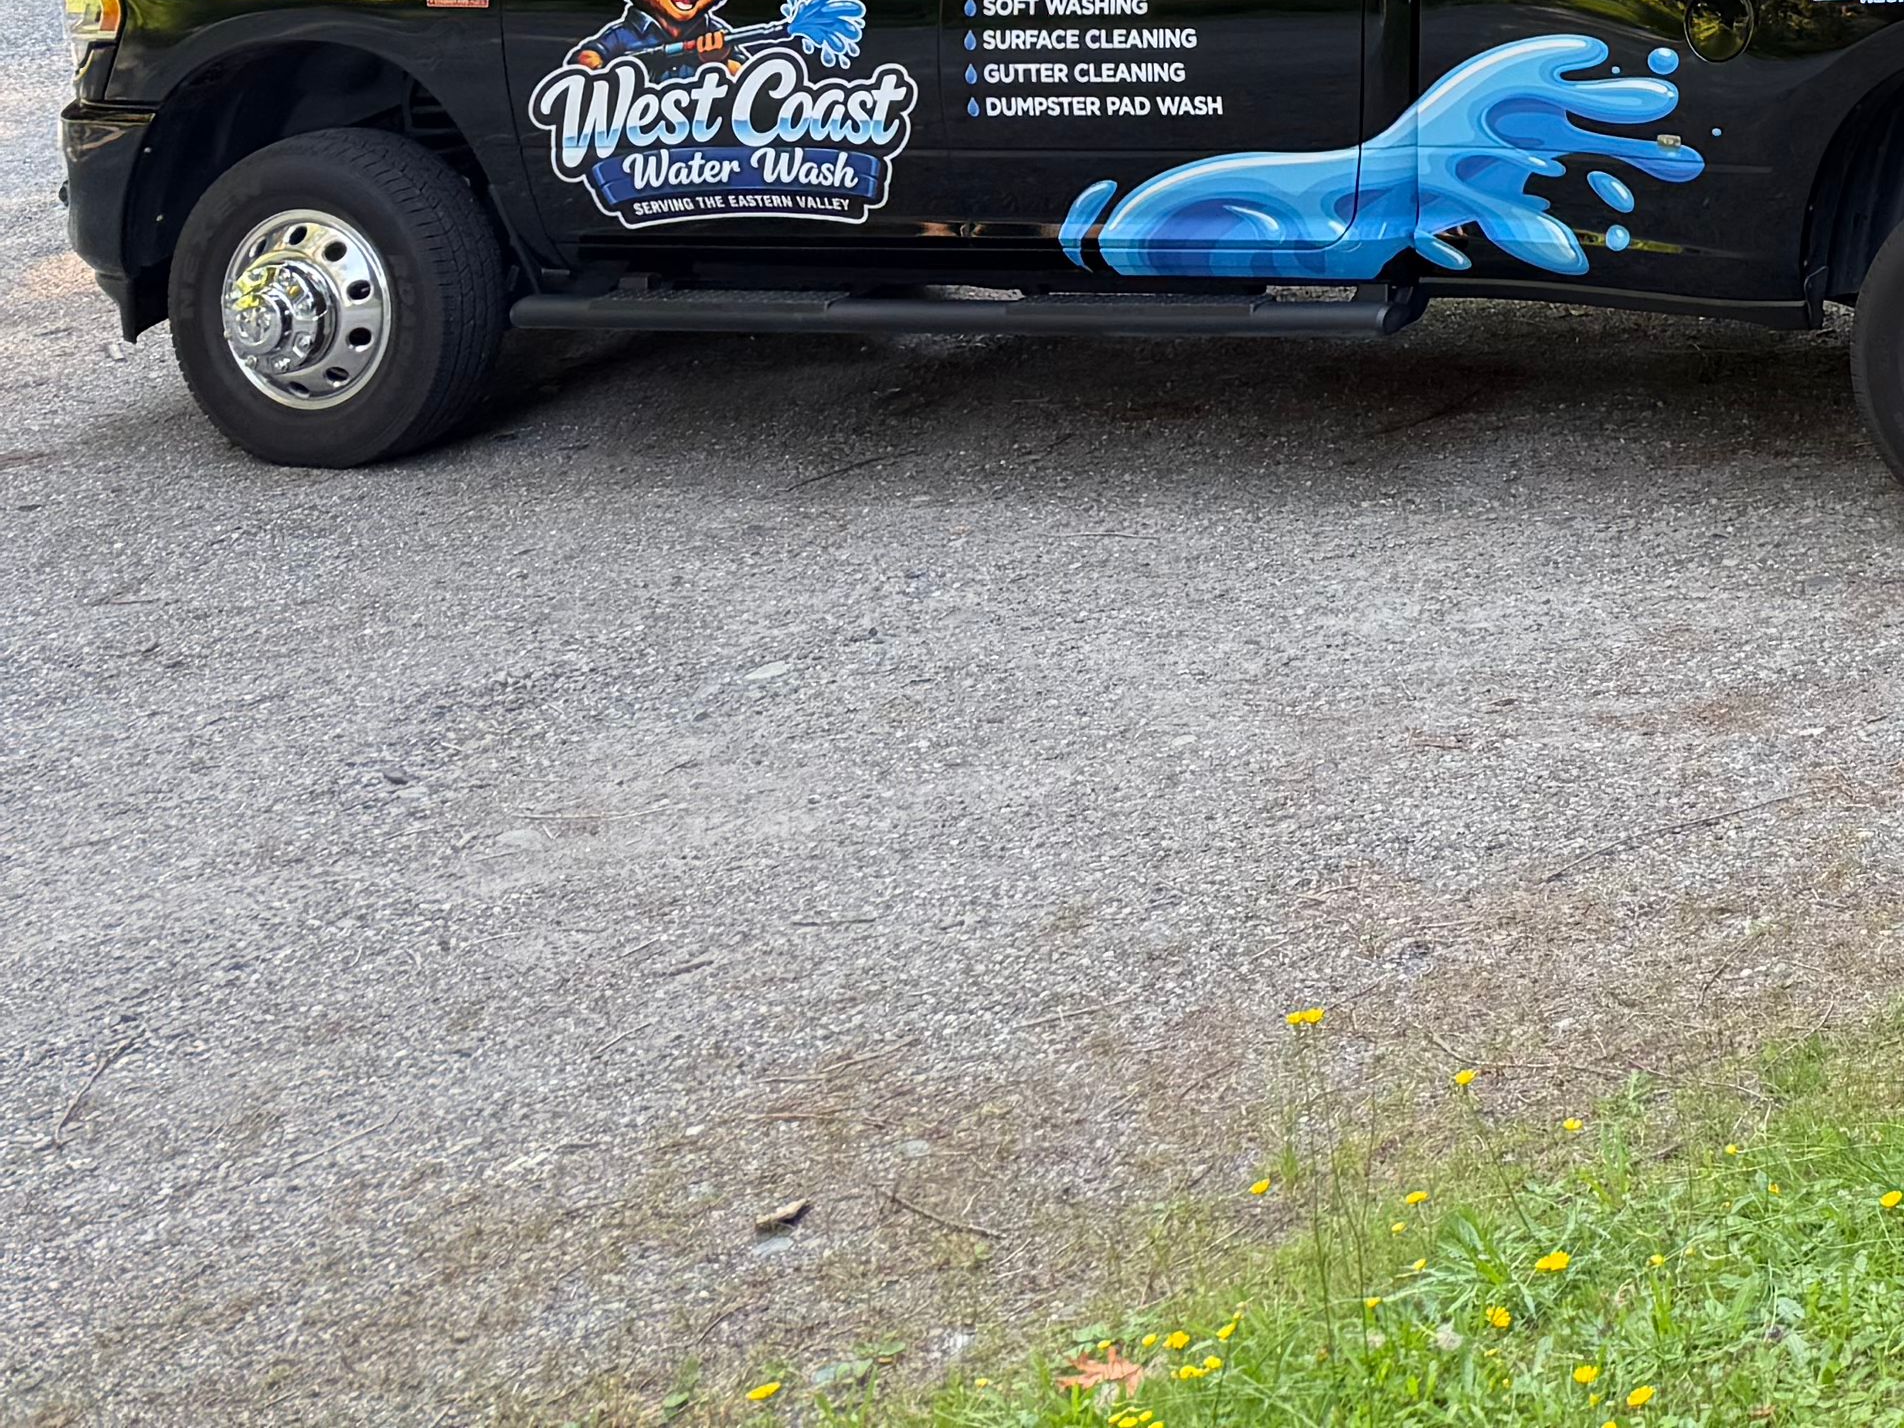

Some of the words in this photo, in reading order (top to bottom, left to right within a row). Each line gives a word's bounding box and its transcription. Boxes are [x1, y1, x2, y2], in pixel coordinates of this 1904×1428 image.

[983, 29, 1080, 50] SURFACE
[1085, 29, 1197, 49] CLEANING
[983, 63, 1068, 83] GUTTER
[1074, 63, 1185, 83] CLEANING
[540, 66, 728, 168] West
[732, 58, 907, 147] Coast
[986, 97, 1101, 117] DUMPSTER
[1107, 96, 1150, 116] PAD
[1156, 96, 1223, 116] WASH
[623, 152, 740, 190] Water
[750, 148, 858, 188] Wash
[633, 197, 694, 217] SERVING
[697, 196, 725, 210] THE
[730, 195, 793, 210] EASTERN
[795, 195, 850, 212] VALLEY
